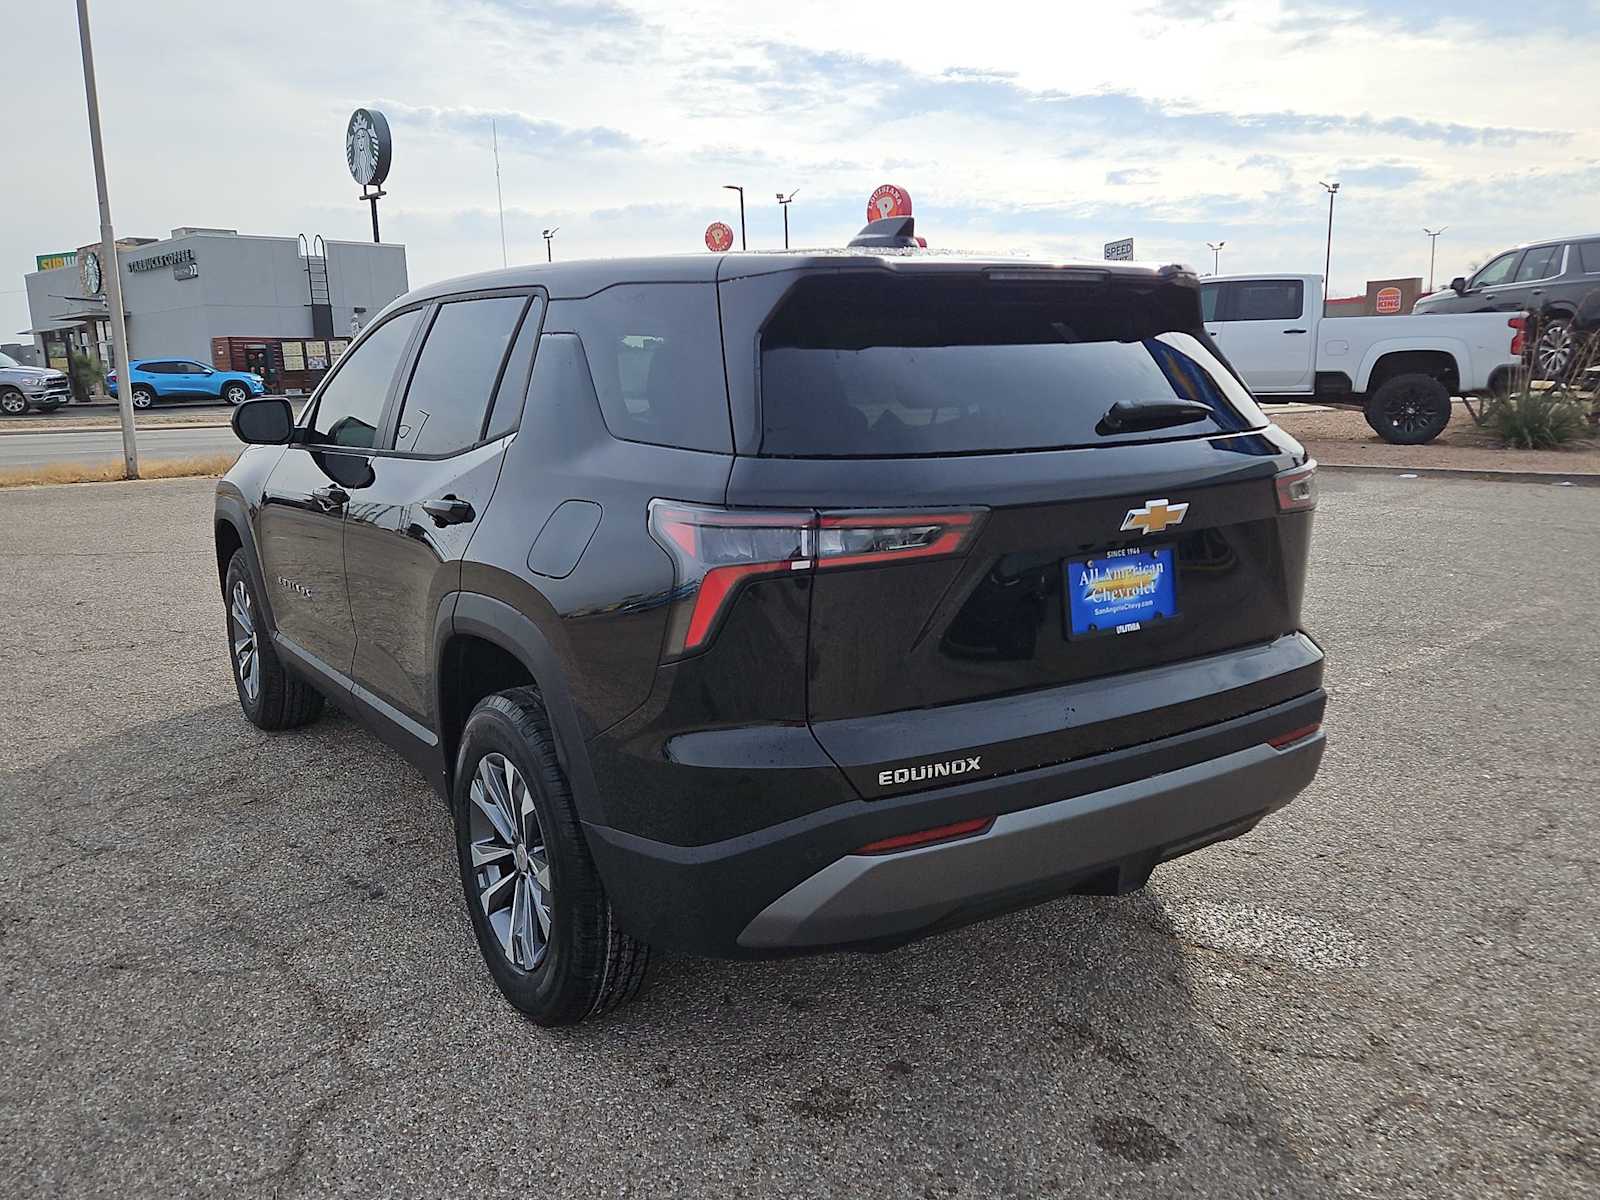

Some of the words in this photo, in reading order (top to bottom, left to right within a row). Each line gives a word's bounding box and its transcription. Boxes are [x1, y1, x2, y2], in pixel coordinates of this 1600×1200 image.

[869, 186, 903, 209] LOUISIANA
[165, 248, 195, 266] COFFEE
[1106, 244, 1132, 258] SPEED
[41, 255, 77, 270] SUBW
[1106, 549, 1126, 559] SINCE
[1080, 568, 1099, 586] All
[1103, 562, 1164, 580] American
[1092, 580, 1156, 603] Chevrolet
[879, 756, 981, 786] EQUINOX
